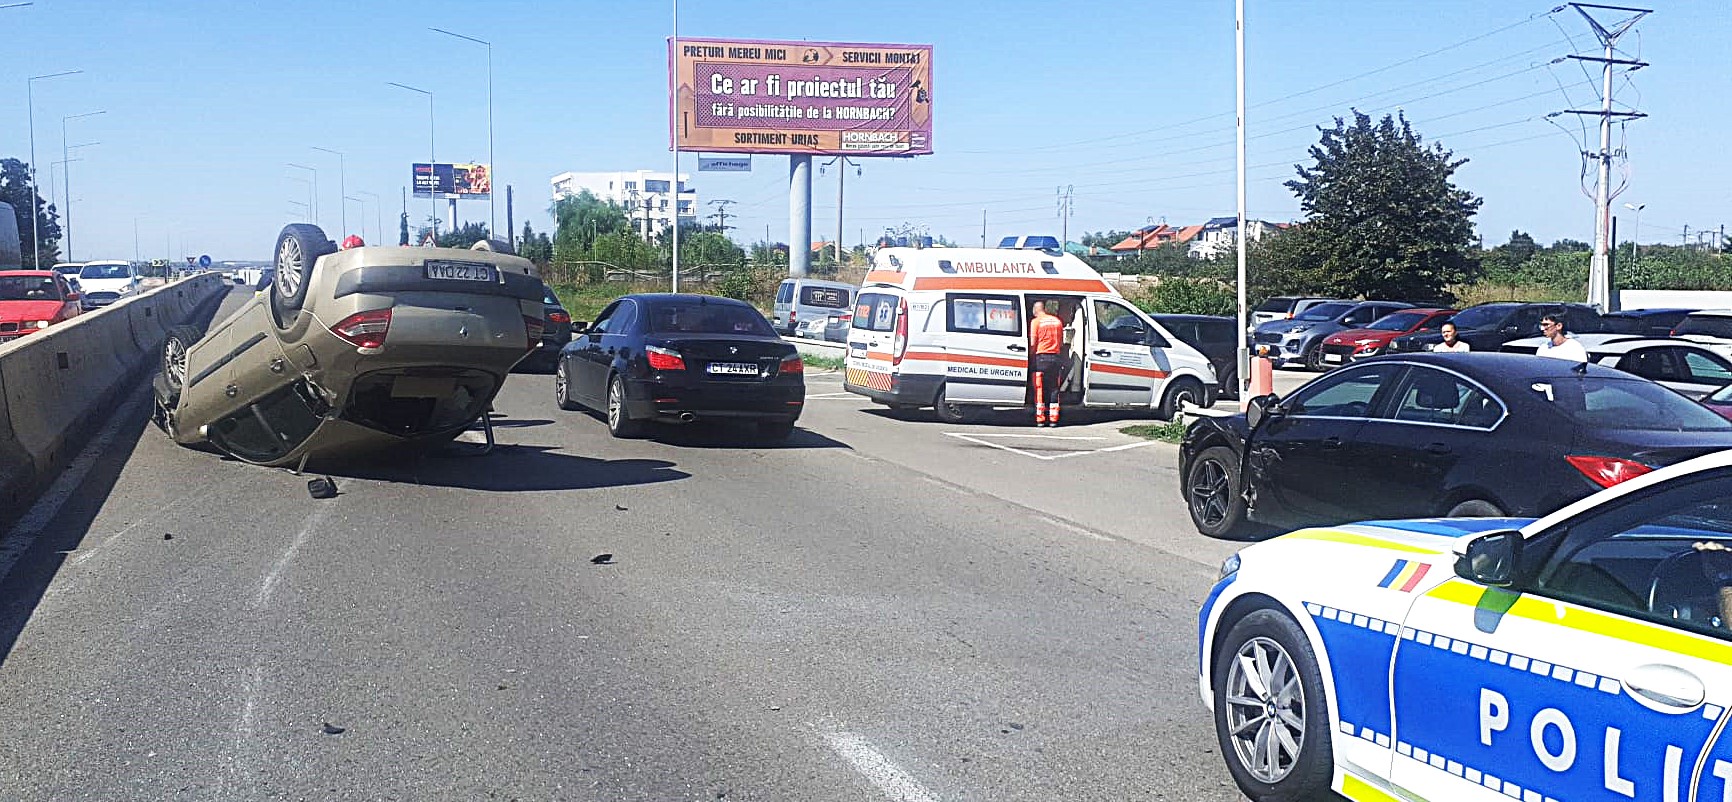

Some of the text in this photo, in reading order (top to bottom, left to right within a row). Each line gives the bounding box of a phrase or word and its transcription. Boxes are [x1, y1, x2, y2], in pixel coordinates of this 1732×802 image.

[728, 47, 761, 59] MEREU
[764, 48, 786, 60] MICI
[842, 51, 881, 63] SERVICII
[711, 73, 896, 101] Ce ar fi proiectul tău
[712, 102, 895, 122] fără posibilitățile de la HORNBACH?
[734, 132, 787, 145] SORTIMENT
[843, 131, 898, 142] HORNBACH
[956, 262, 1036, 274] AMBULANTA
[712, 363, 724, 373] CT
[947, 366, 1022, 377] MEDICAL DE URGENTA
